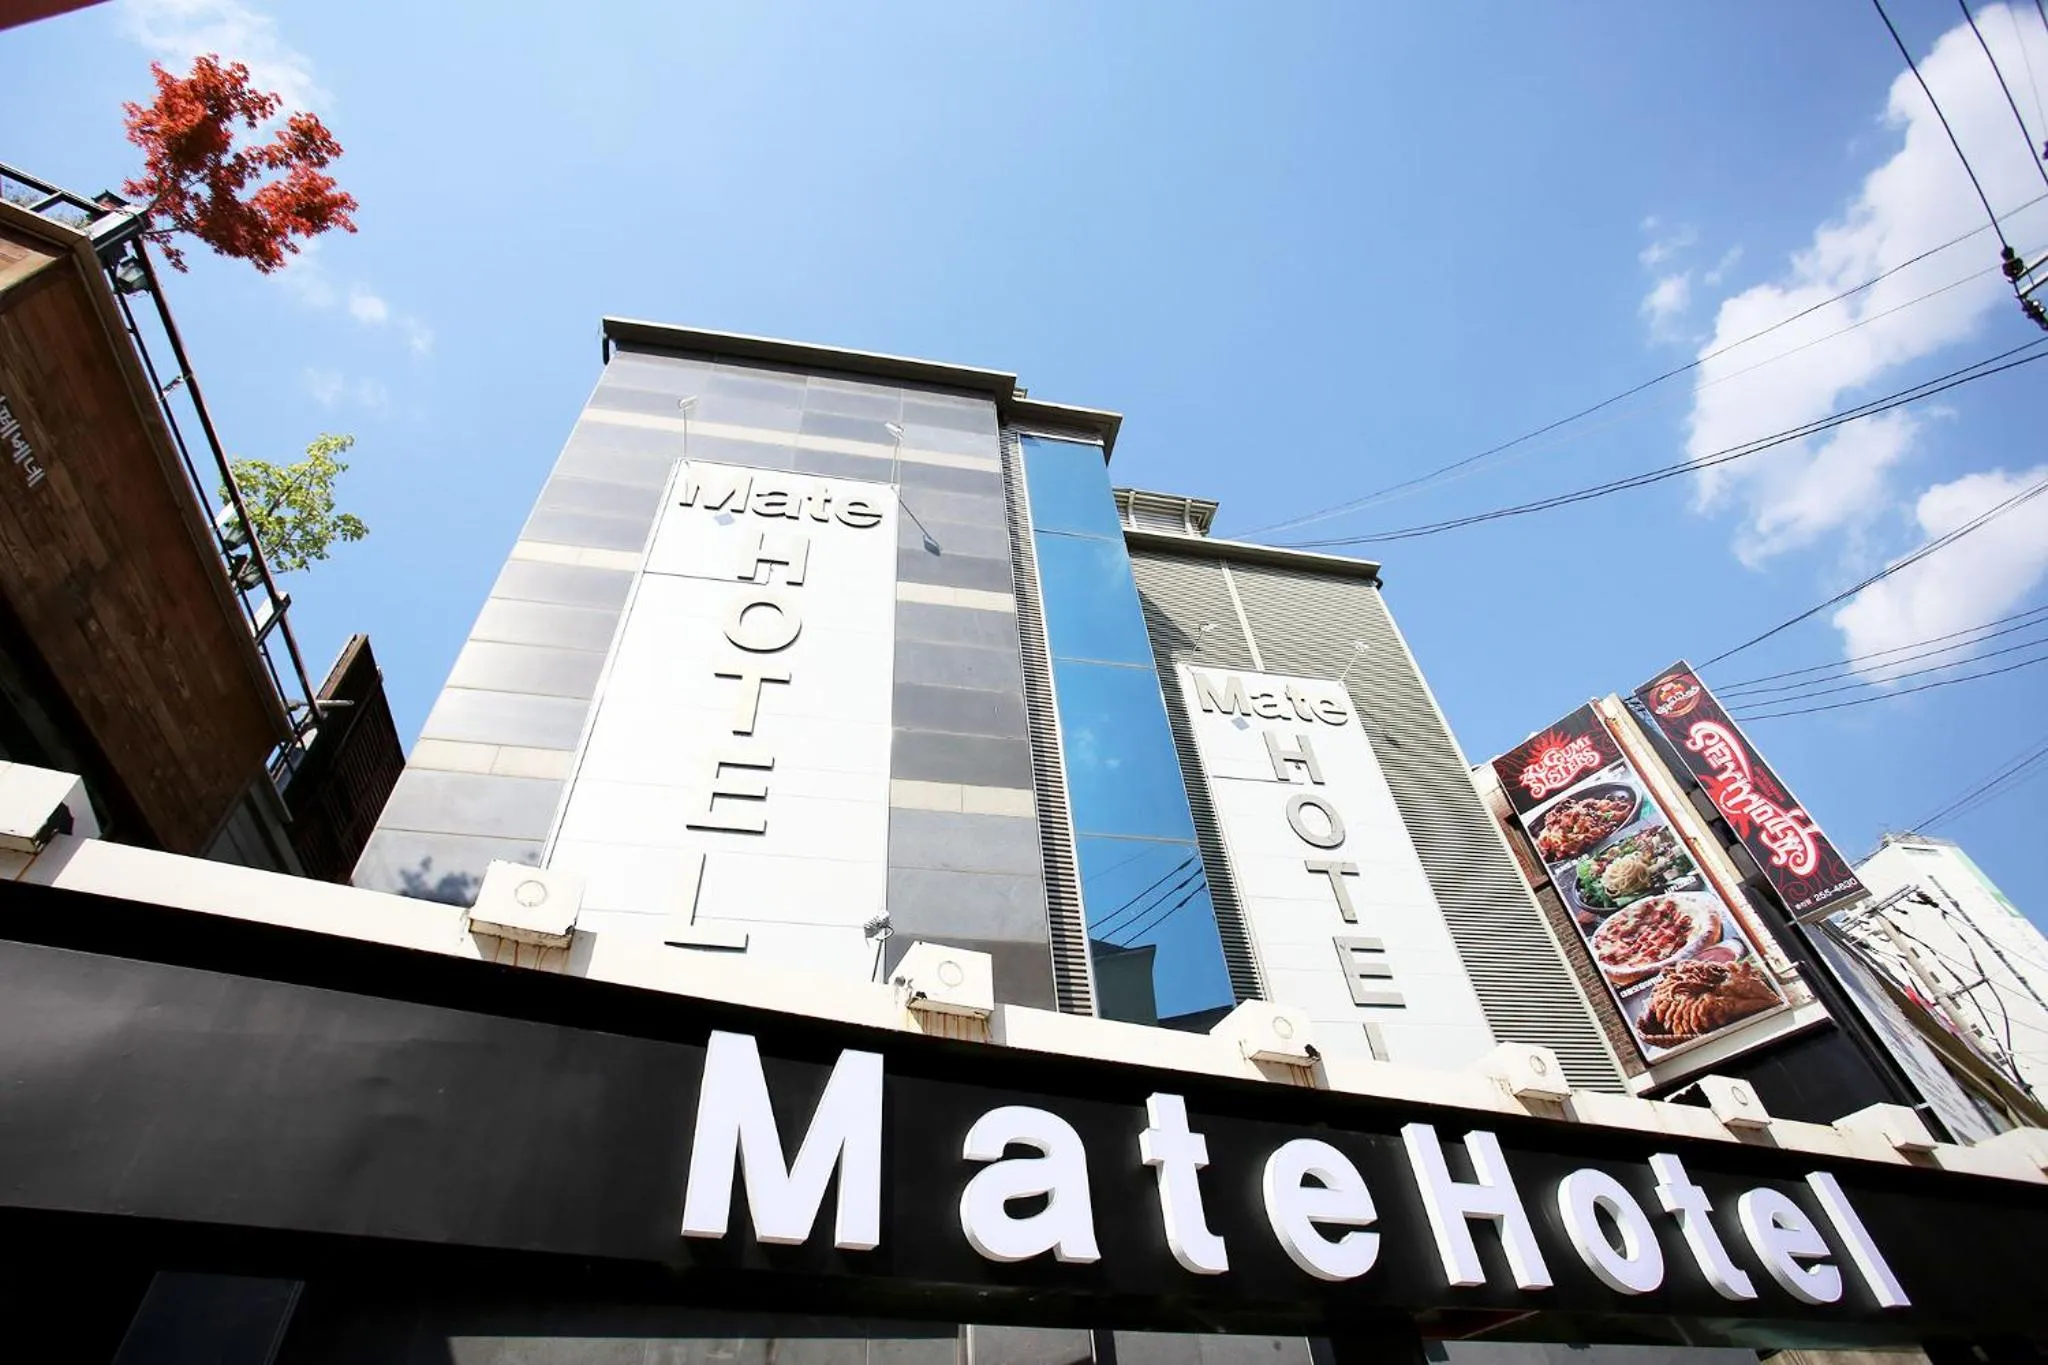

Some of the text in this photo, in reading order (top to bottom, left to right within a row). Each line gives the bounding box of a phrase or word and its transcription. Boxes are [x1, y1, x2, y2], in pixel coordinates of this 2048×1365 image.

[0, 395, 45, 488] 페베네
[679, 466, 883, 528] Mate
[1195, 673, 1348, 726] Mate
[664, 530, 810, 954] HOTEL
[1530, 747, 1601, 799] SISTERS
